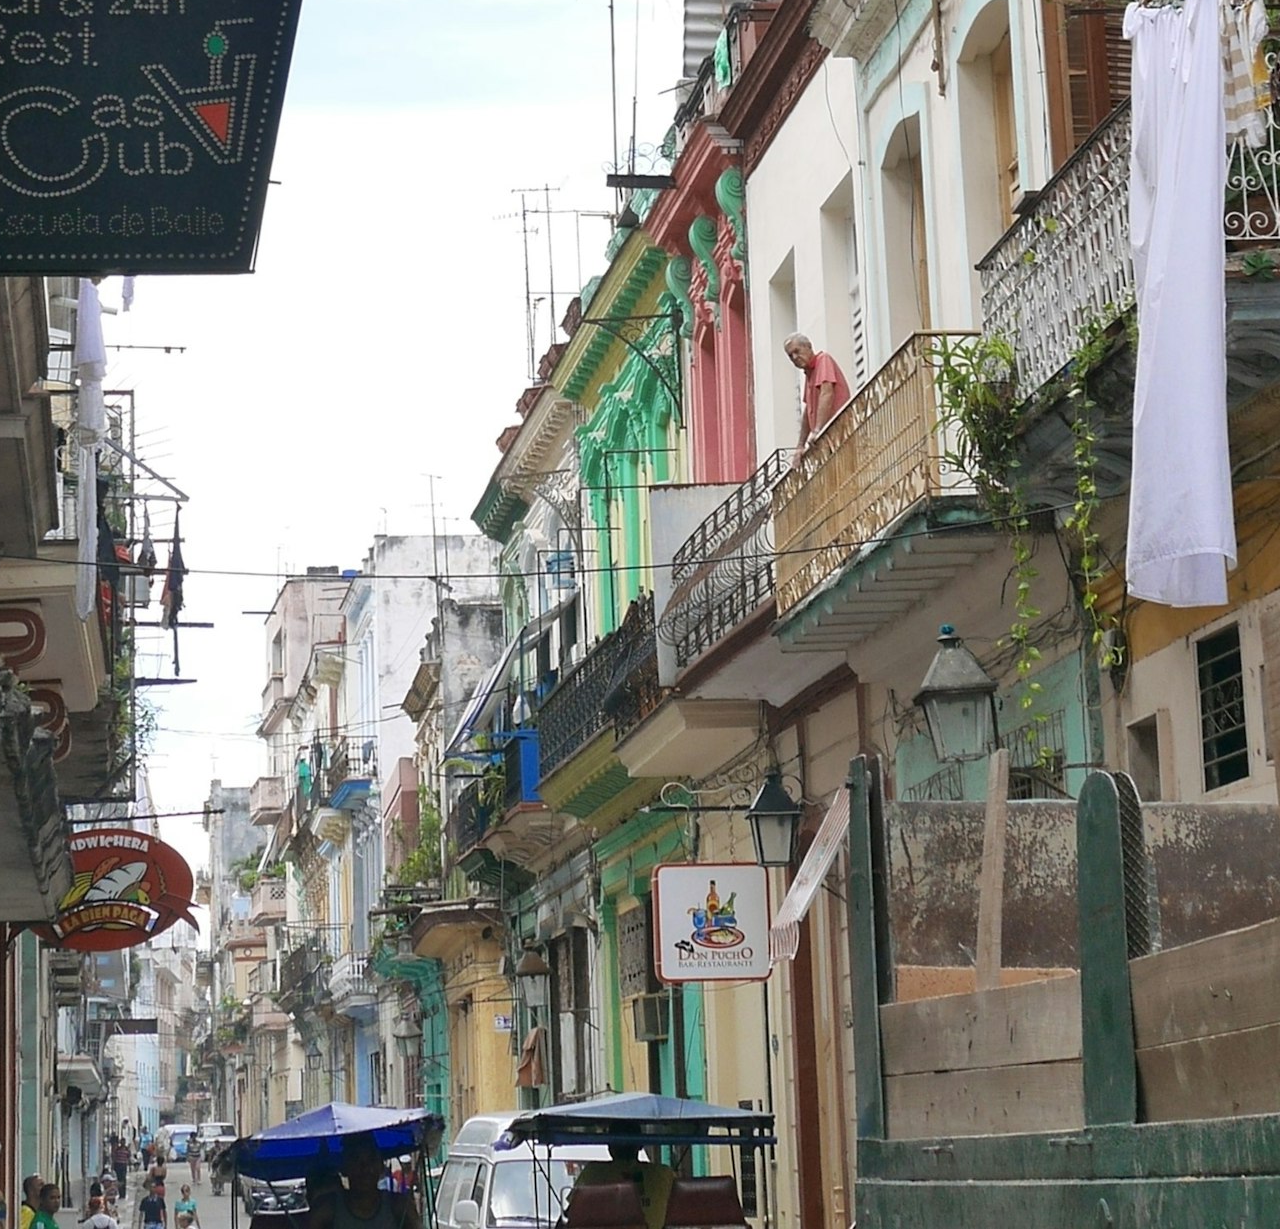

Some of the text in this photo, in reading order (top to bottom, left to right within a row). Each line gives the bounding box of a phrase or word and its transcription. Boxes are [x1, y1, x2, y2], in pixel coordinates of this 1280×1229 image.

[108, 205, 144, 237] de
[150, 206, 225, 236] Baile
[80, 906, 110, 923] BIEN
